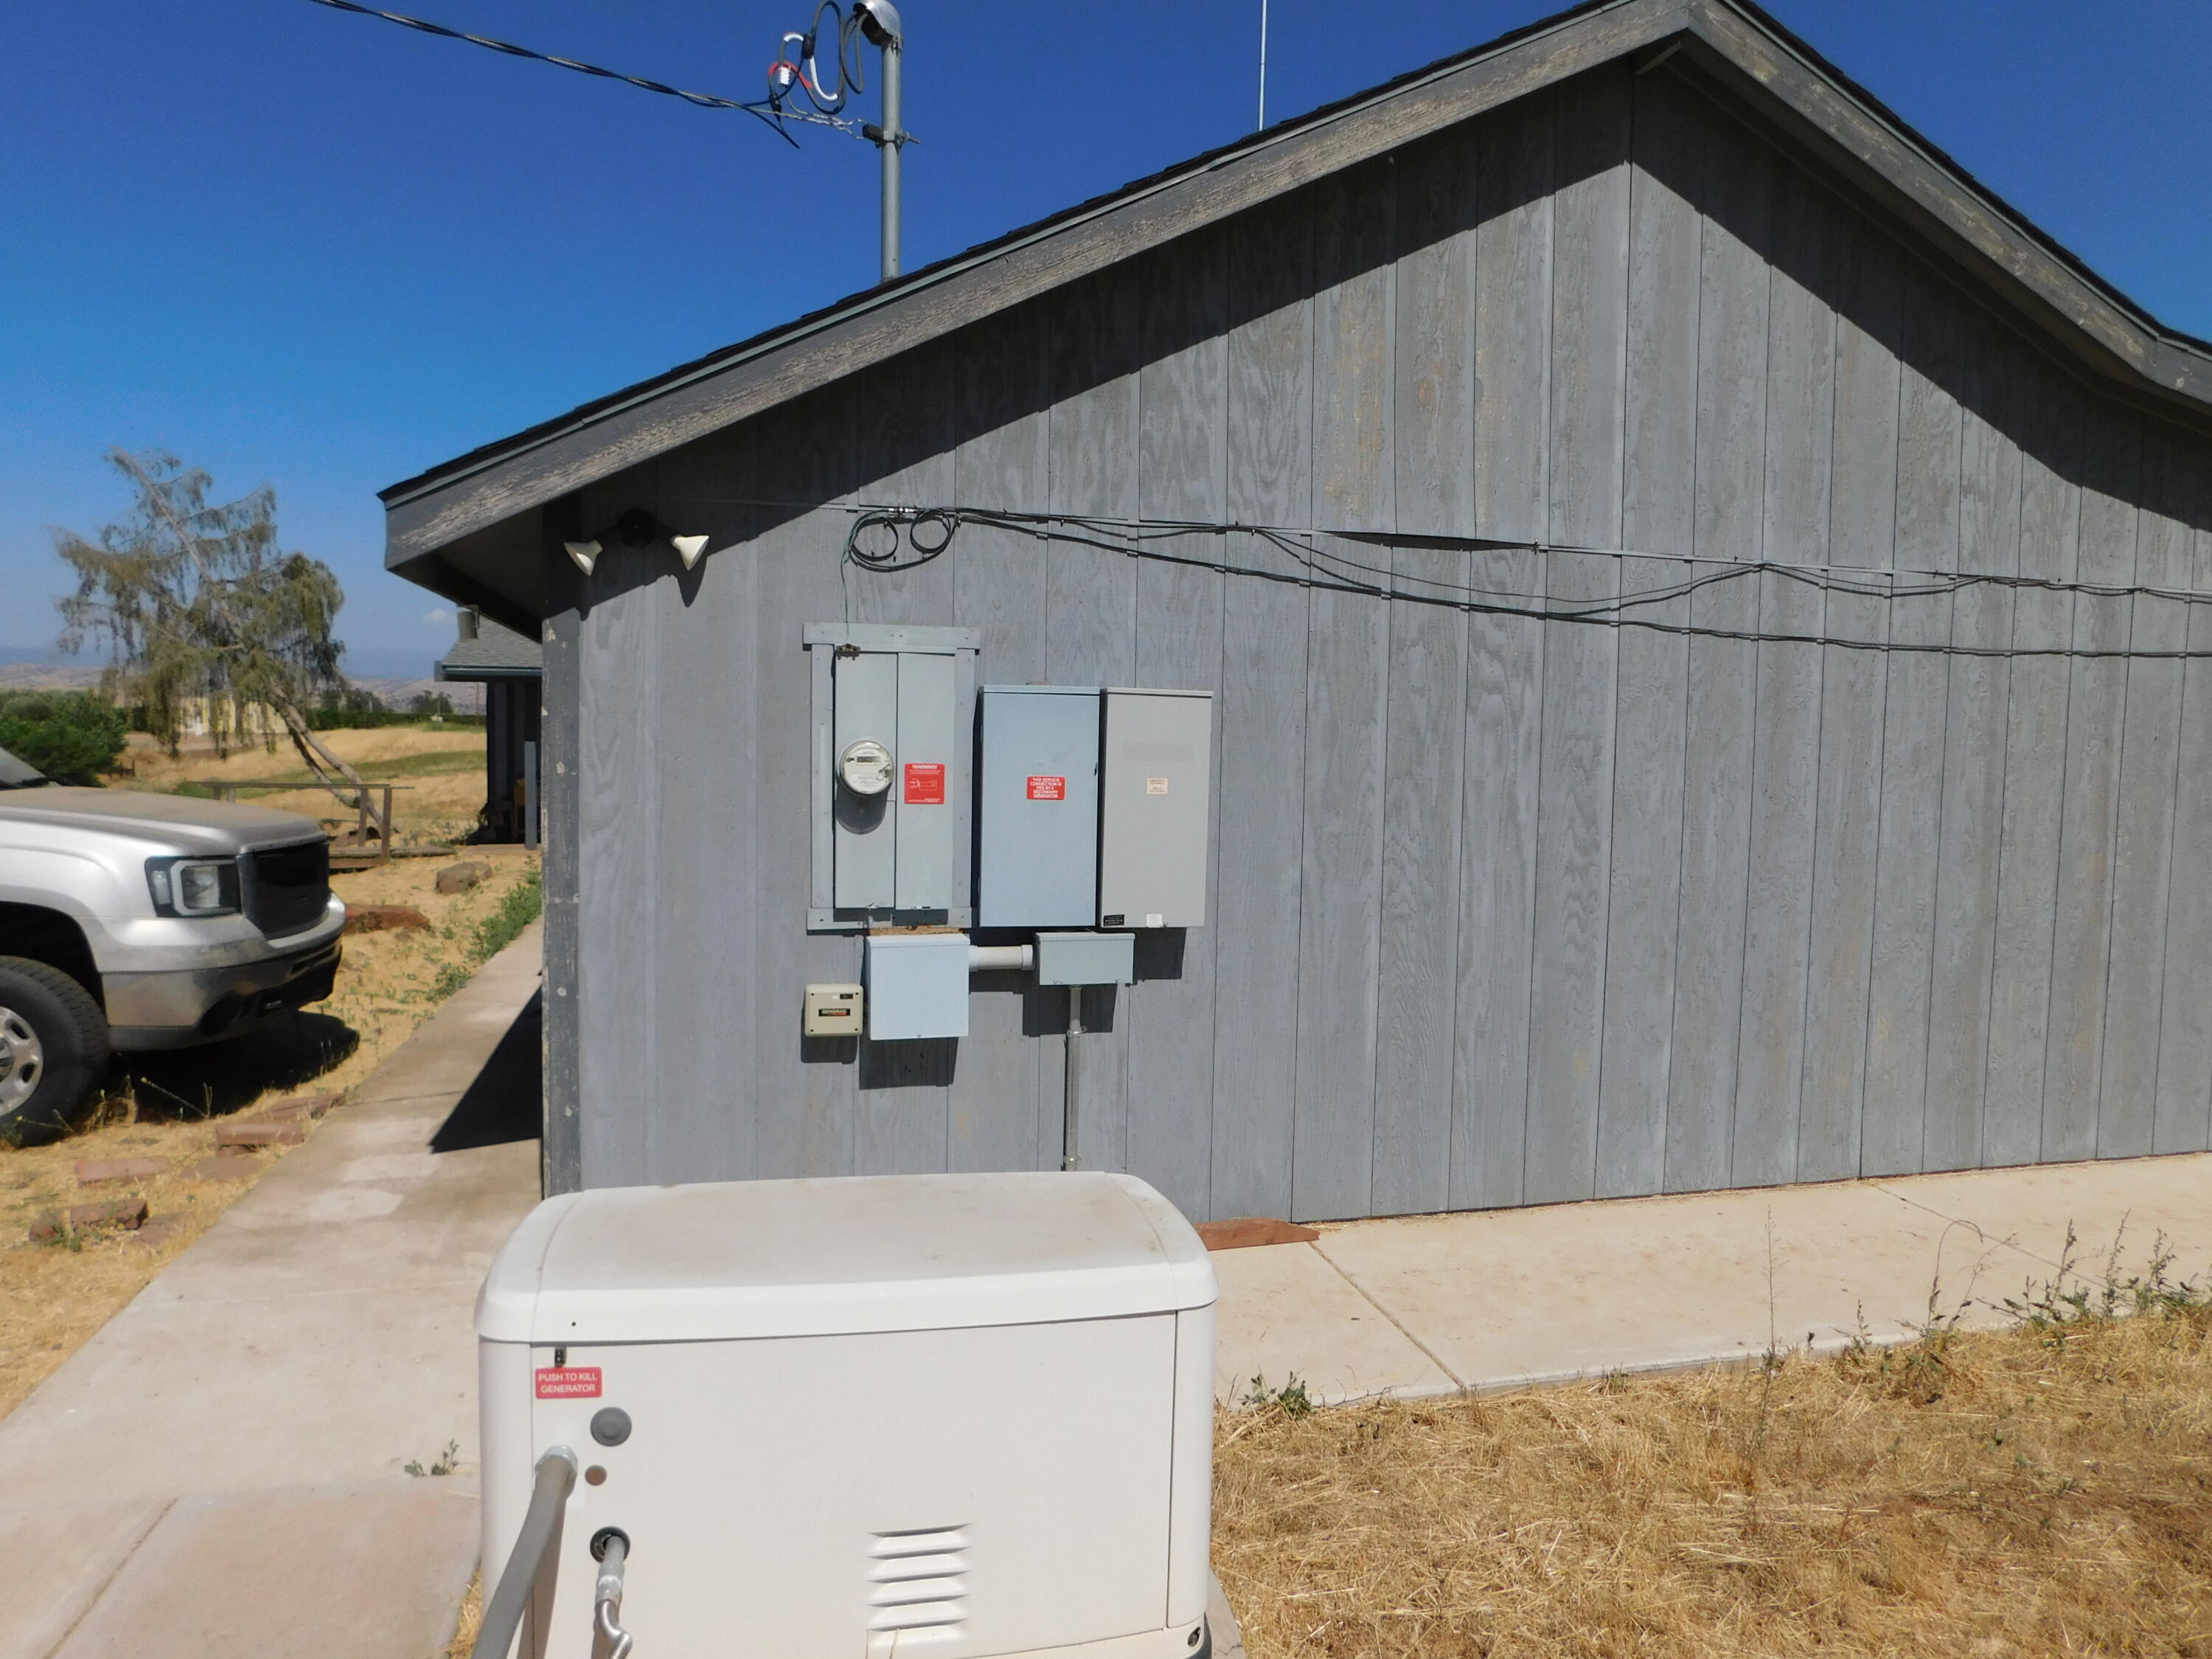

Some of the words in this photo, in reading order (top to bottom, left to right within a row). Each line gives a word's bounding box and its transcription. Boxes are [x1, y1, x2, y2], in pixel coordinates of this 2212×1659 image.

[538, 1373, 563, 1382] PUSH
[566, 1372, 577, 1381] TO
[579, 1372, 598, 1381] KILL
[541, 1384, 596, 1394] GENERATOR
